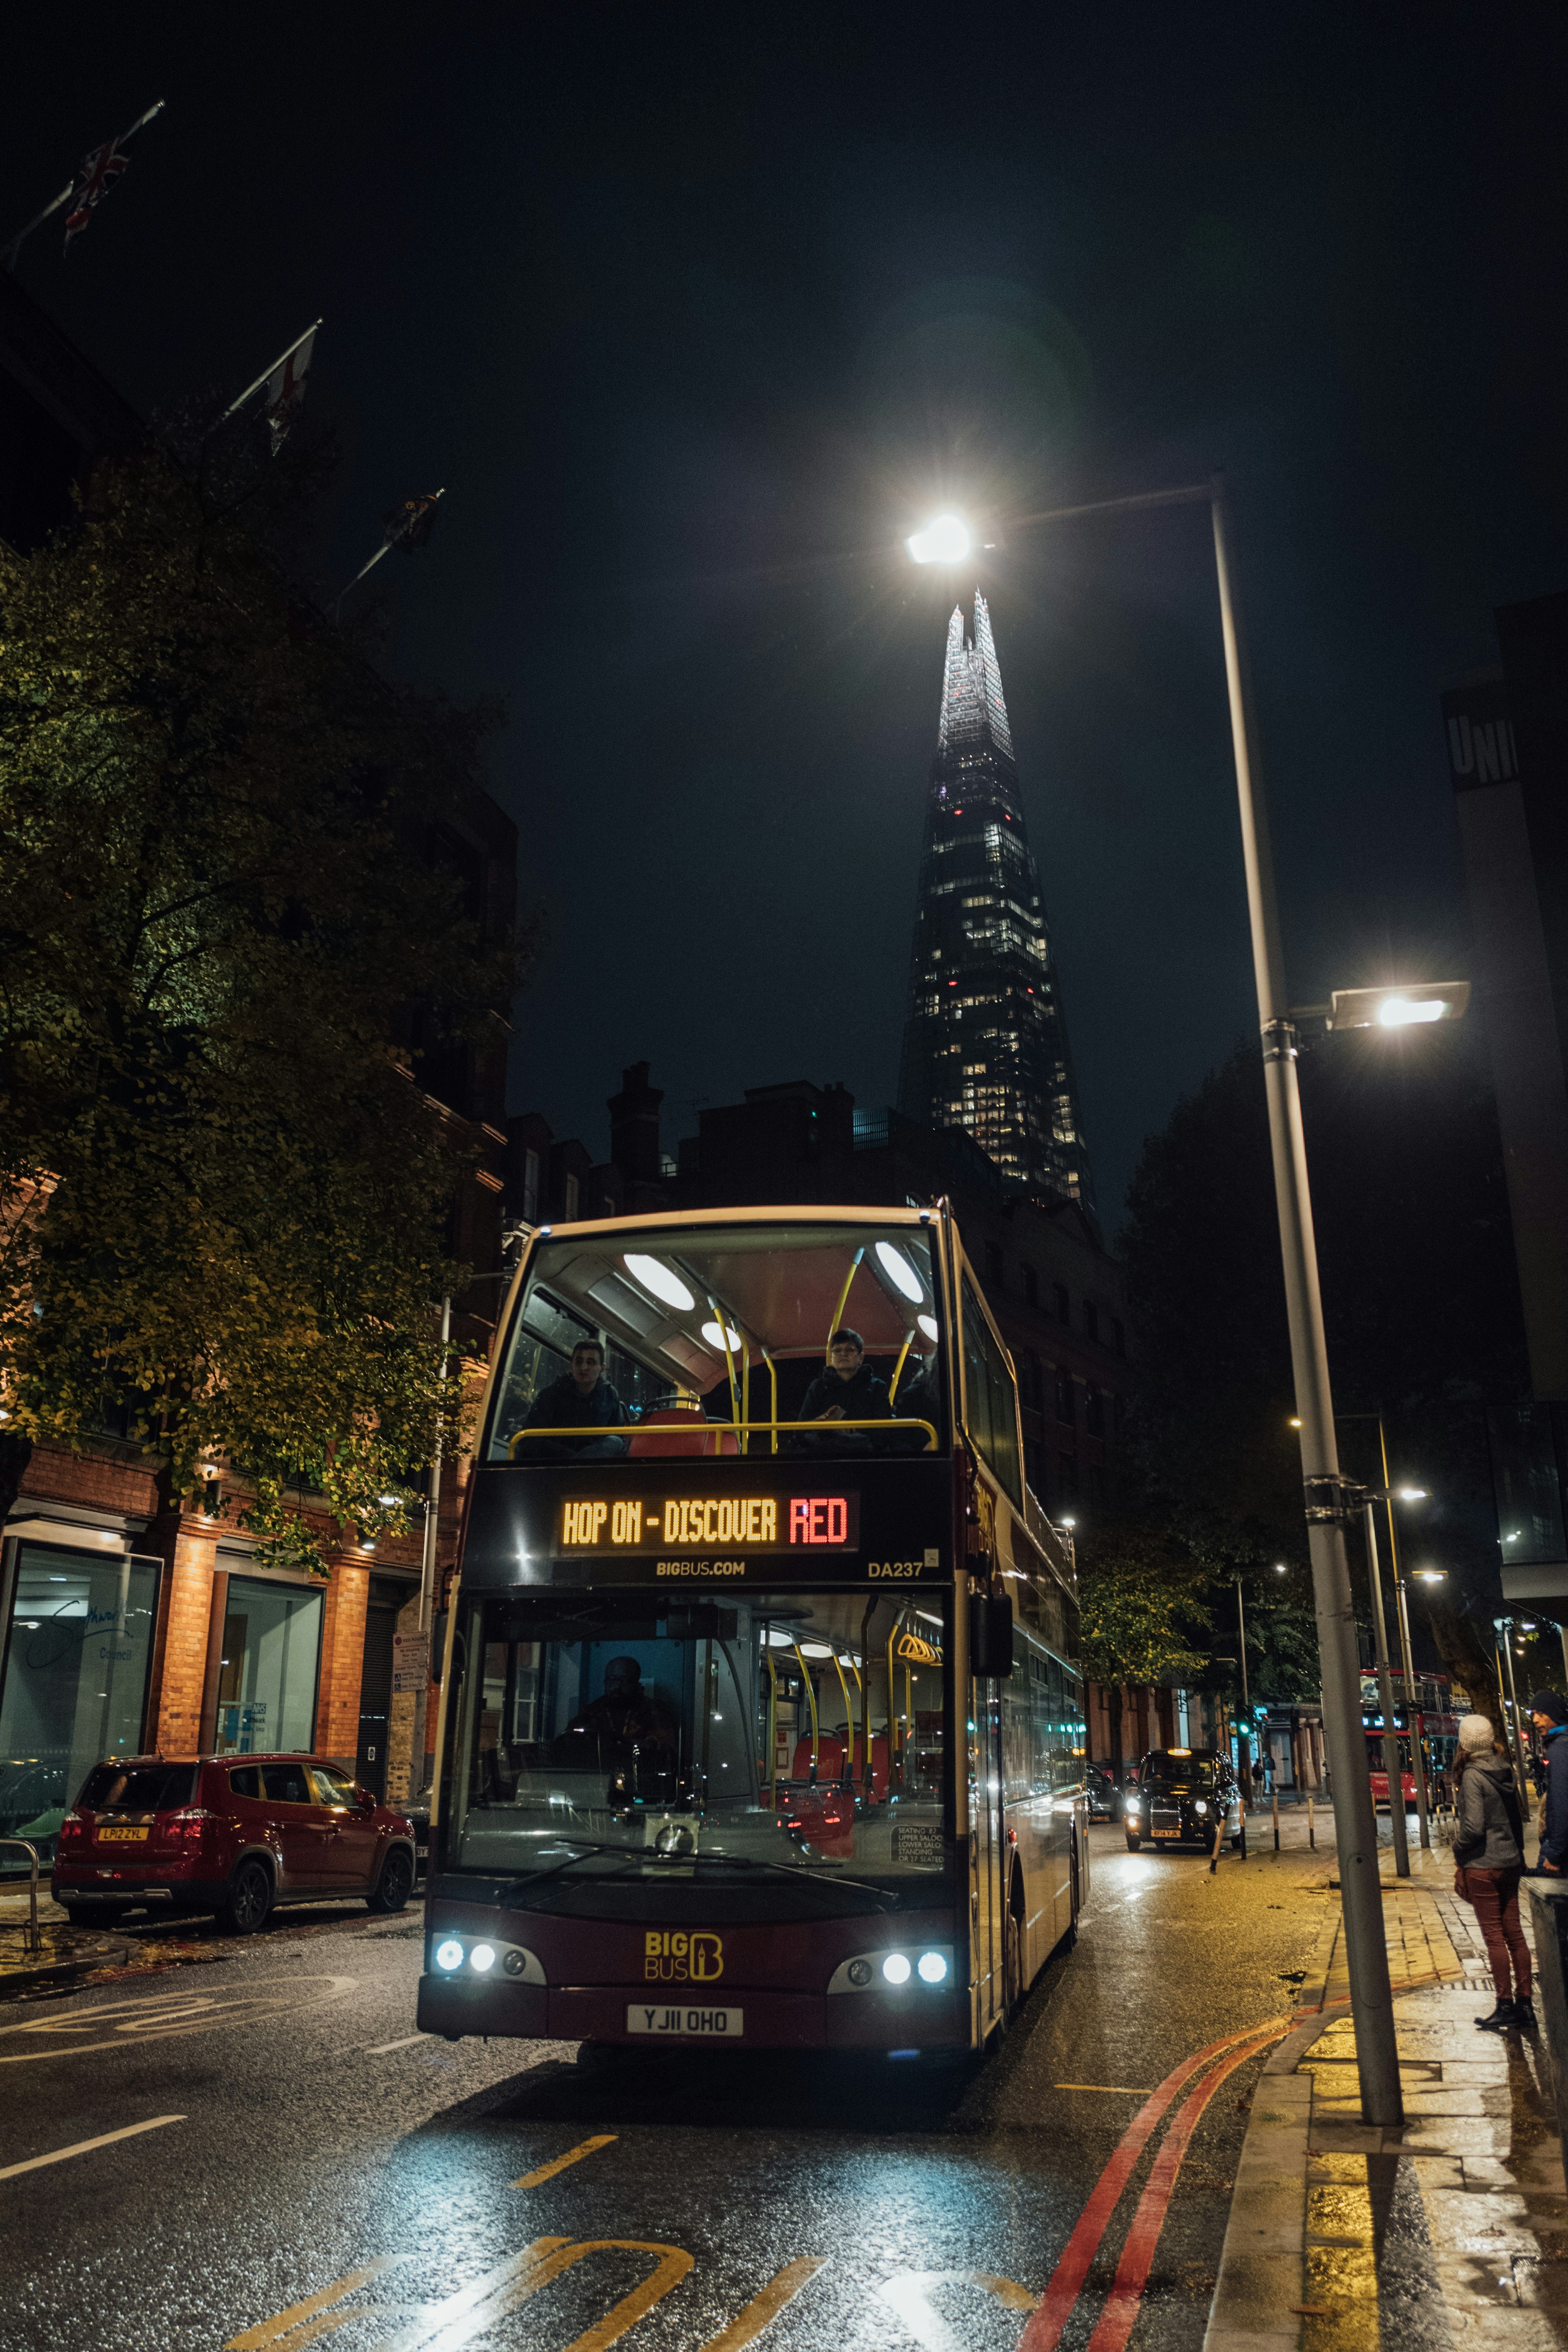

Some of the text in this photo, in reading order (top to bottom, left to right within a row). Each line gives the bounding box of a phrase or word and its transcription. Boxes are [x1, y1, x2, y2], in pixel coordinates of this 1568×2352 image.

[564, 1503, 607, 1543] HOP
[612, 1502, 641, 1543] ON
[665, 1500, 776, 1542] DISCOVER
[790, 1498, 847, 1543] RED
[656, 1561, 745, 1575] BIGBUS.COM
[869, 1562, 923, 1577] DA237
[100, 1647, 132, 1661] Council
[252, 1704, 266, 1713] NHS
[104, 1829, 123, 1839] LP12
[645, 1931, 688, 1956] BIG
[645, 1957, 688, 1980] BUS
[645, 2009, 727, 2032] YJ11 OHO
